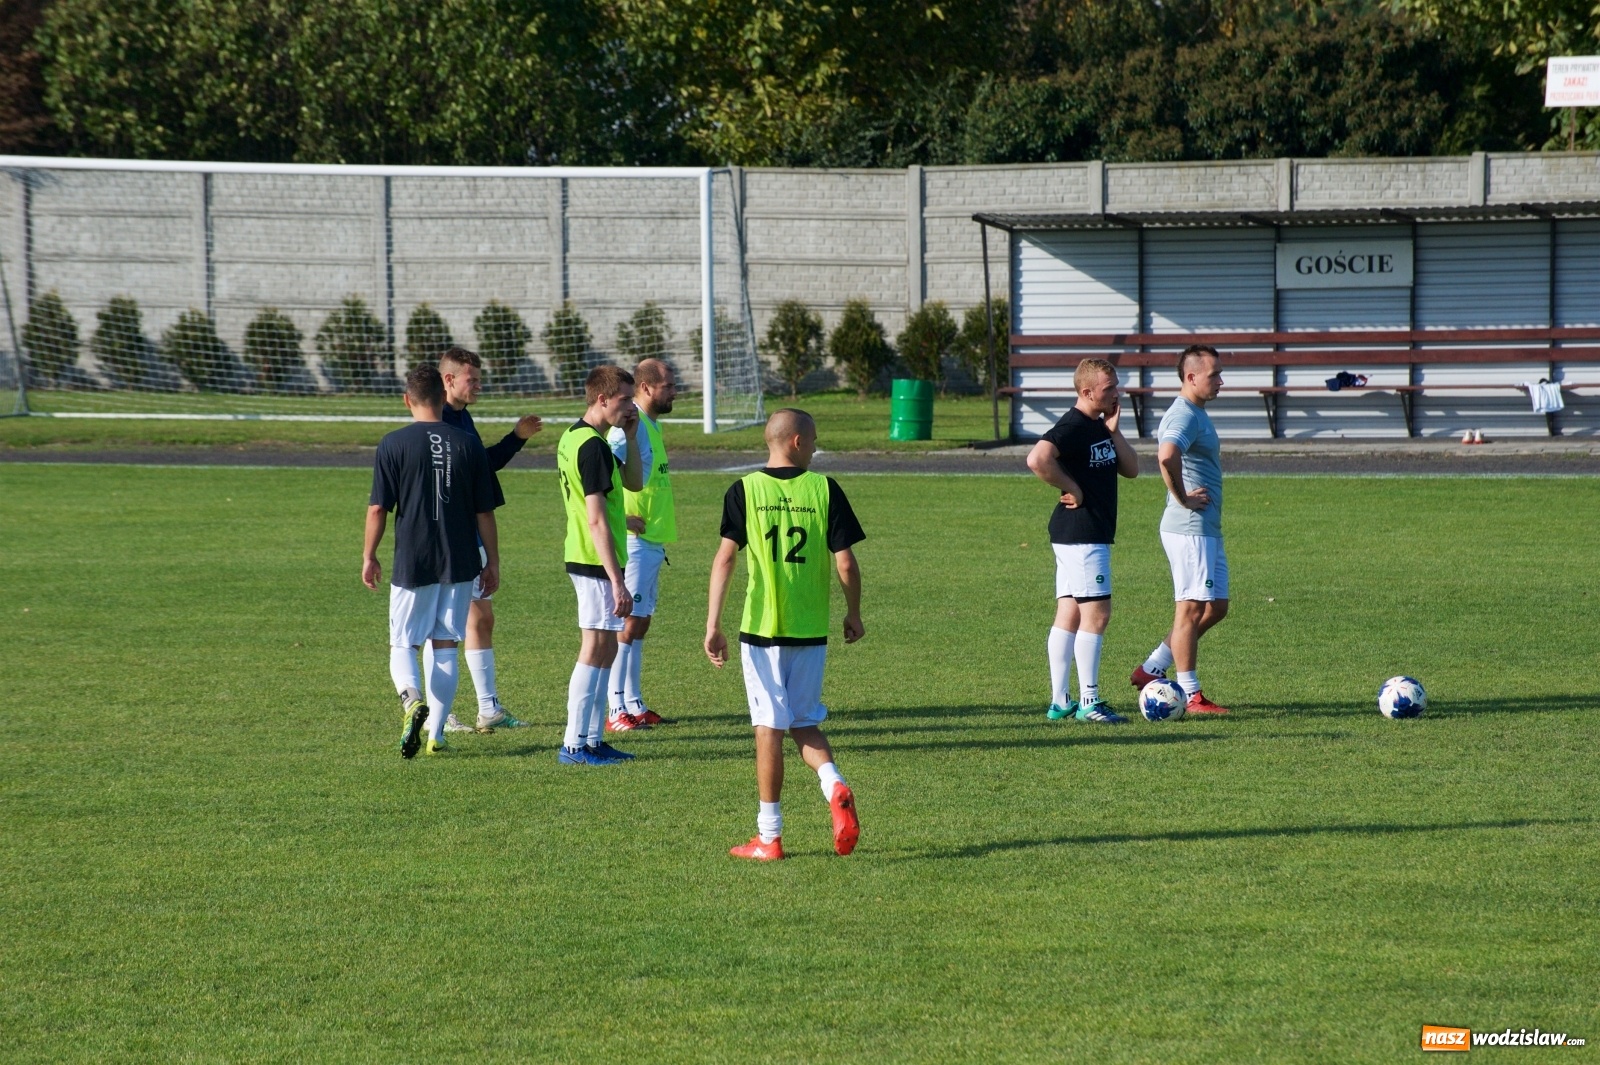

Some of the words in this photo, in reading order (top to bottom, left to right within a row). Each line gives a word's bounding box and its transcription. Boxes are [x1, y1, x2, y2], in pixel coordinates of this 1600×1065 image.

[1295, 250, 1394, 275] GOŚCIE
[757, 505, 786, 513] POLONIA
[765, 524, 808, 564] 12
